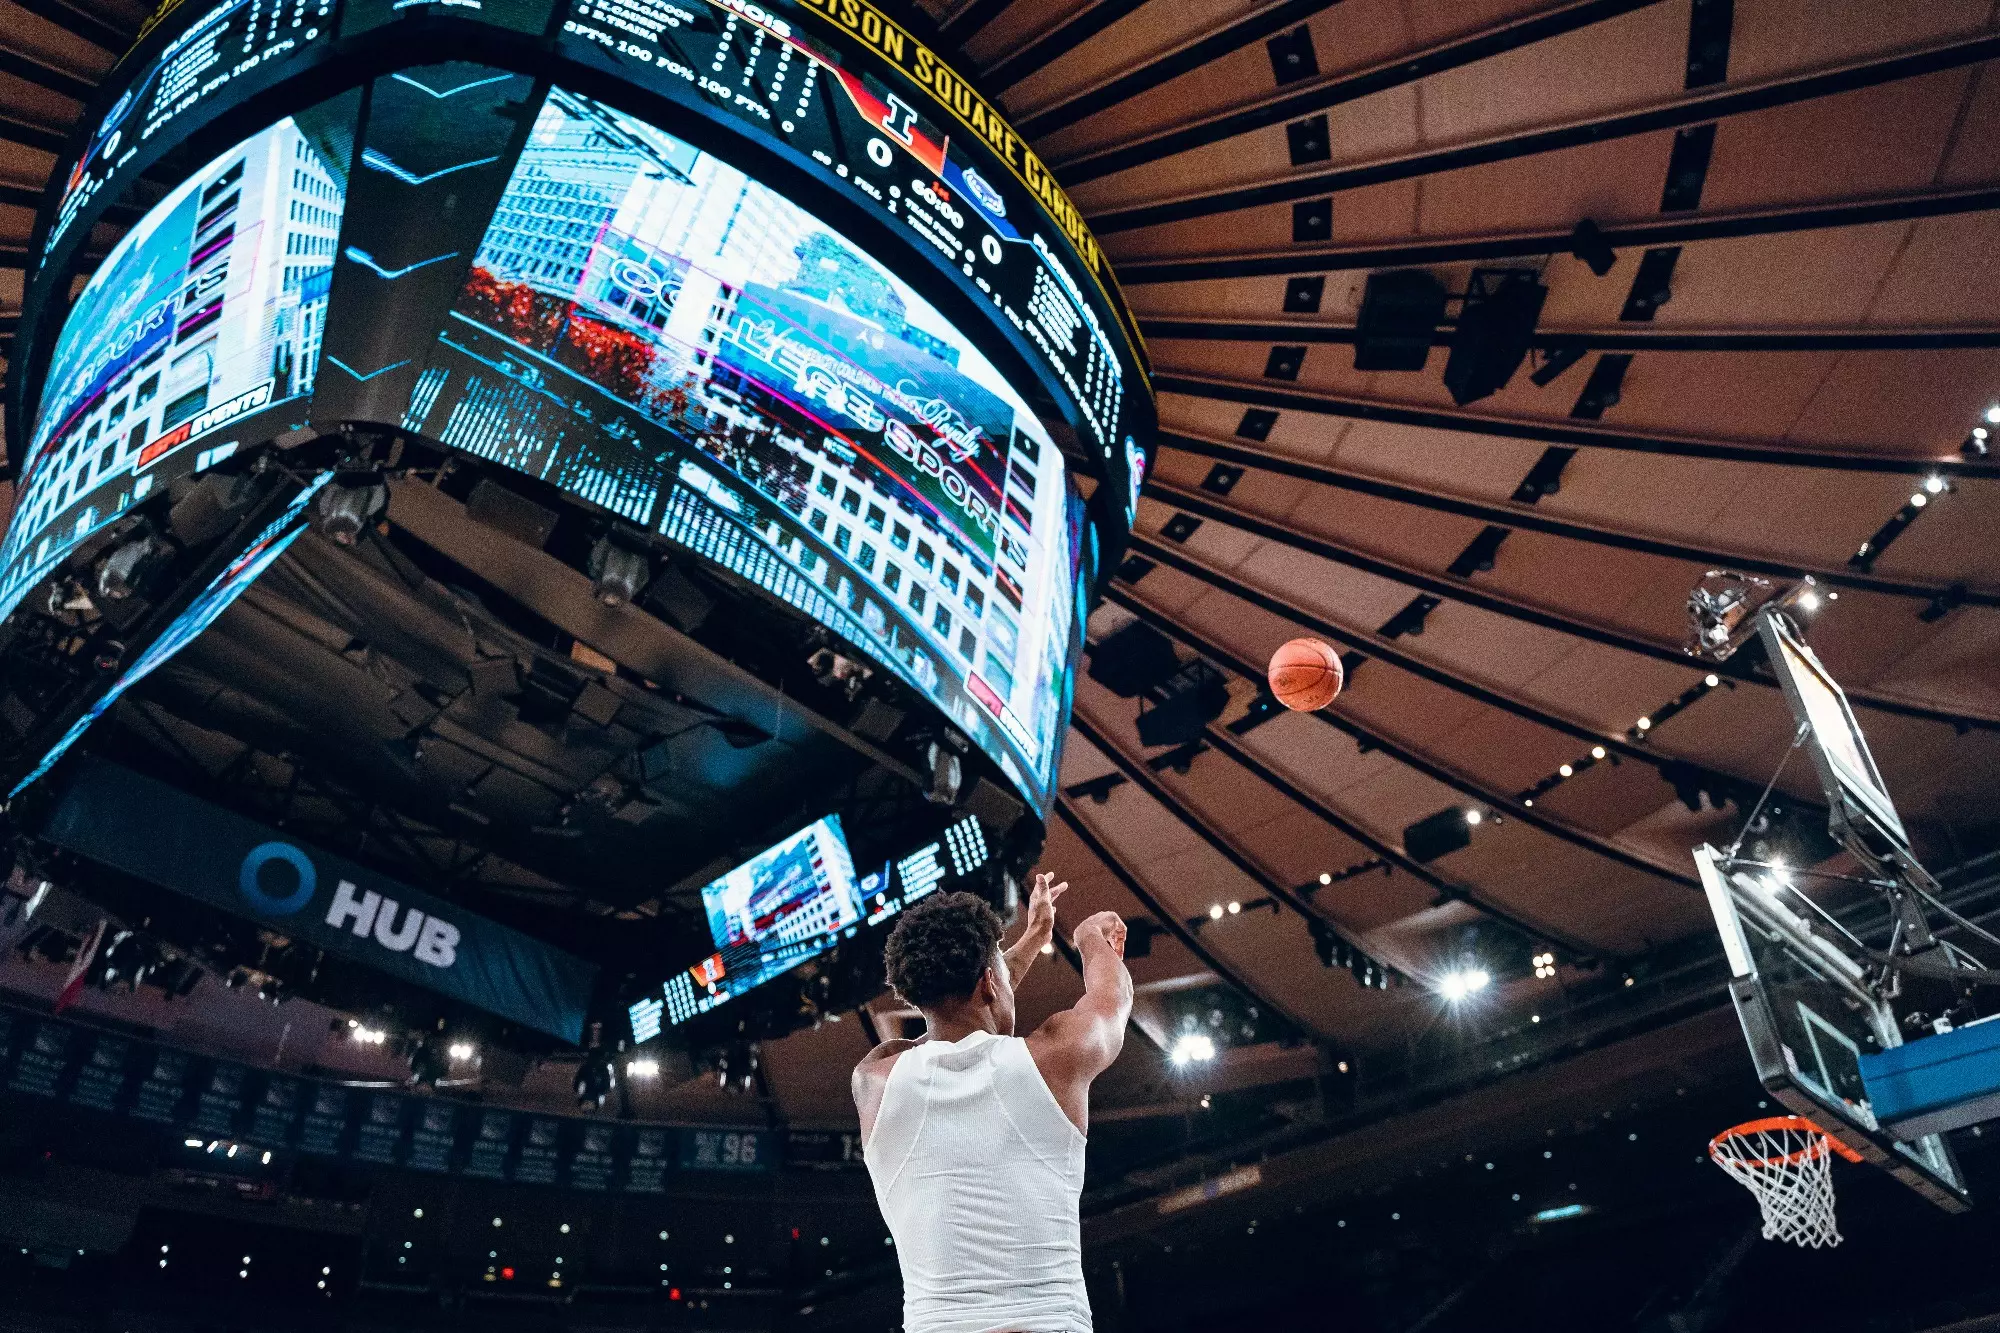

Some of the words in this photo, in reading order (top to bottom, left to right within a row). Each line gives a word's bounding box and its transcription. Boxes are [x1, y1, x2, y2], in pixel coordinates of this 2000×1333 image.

[162, 0, 233, 60] FLORIDA
[721, 0, 791, 38] NOIS
[175, 92, 198, 114] 100
[232, 55, 259, 77] 100
[306, 28, 318, 39] 0
[564, 21, 614, 46] 3PT%
[617, 41, 652, 61] 100
[698, 76, 731, 98] 100
[735, 94, 770, 119] FT%
[782, 121, 794, 132] 0
[103, 131, 121, 159] 0
[809, 0, 905, 62] ISON
[913, 46, 1020, 167] SQUARE
[1024, 150, 1102, 275] GARDEN
[881, 93, 918, 146] I
[867, 138, 892, 167] 0
[854, 176, 882, 200] FULL
[889, 185, 900, 198] 0
[911, 180, 963, 228] 60:00
[982, 235, 1002, 264] 0
[69, 261, 229, 405] SPORTS
[190, 383, 269, 436] EVENTS
[884, 418, 1028, 571] SPORTS
[324, 878, 462, 969] HUB
[723, 1133, 757, 1164] 96
